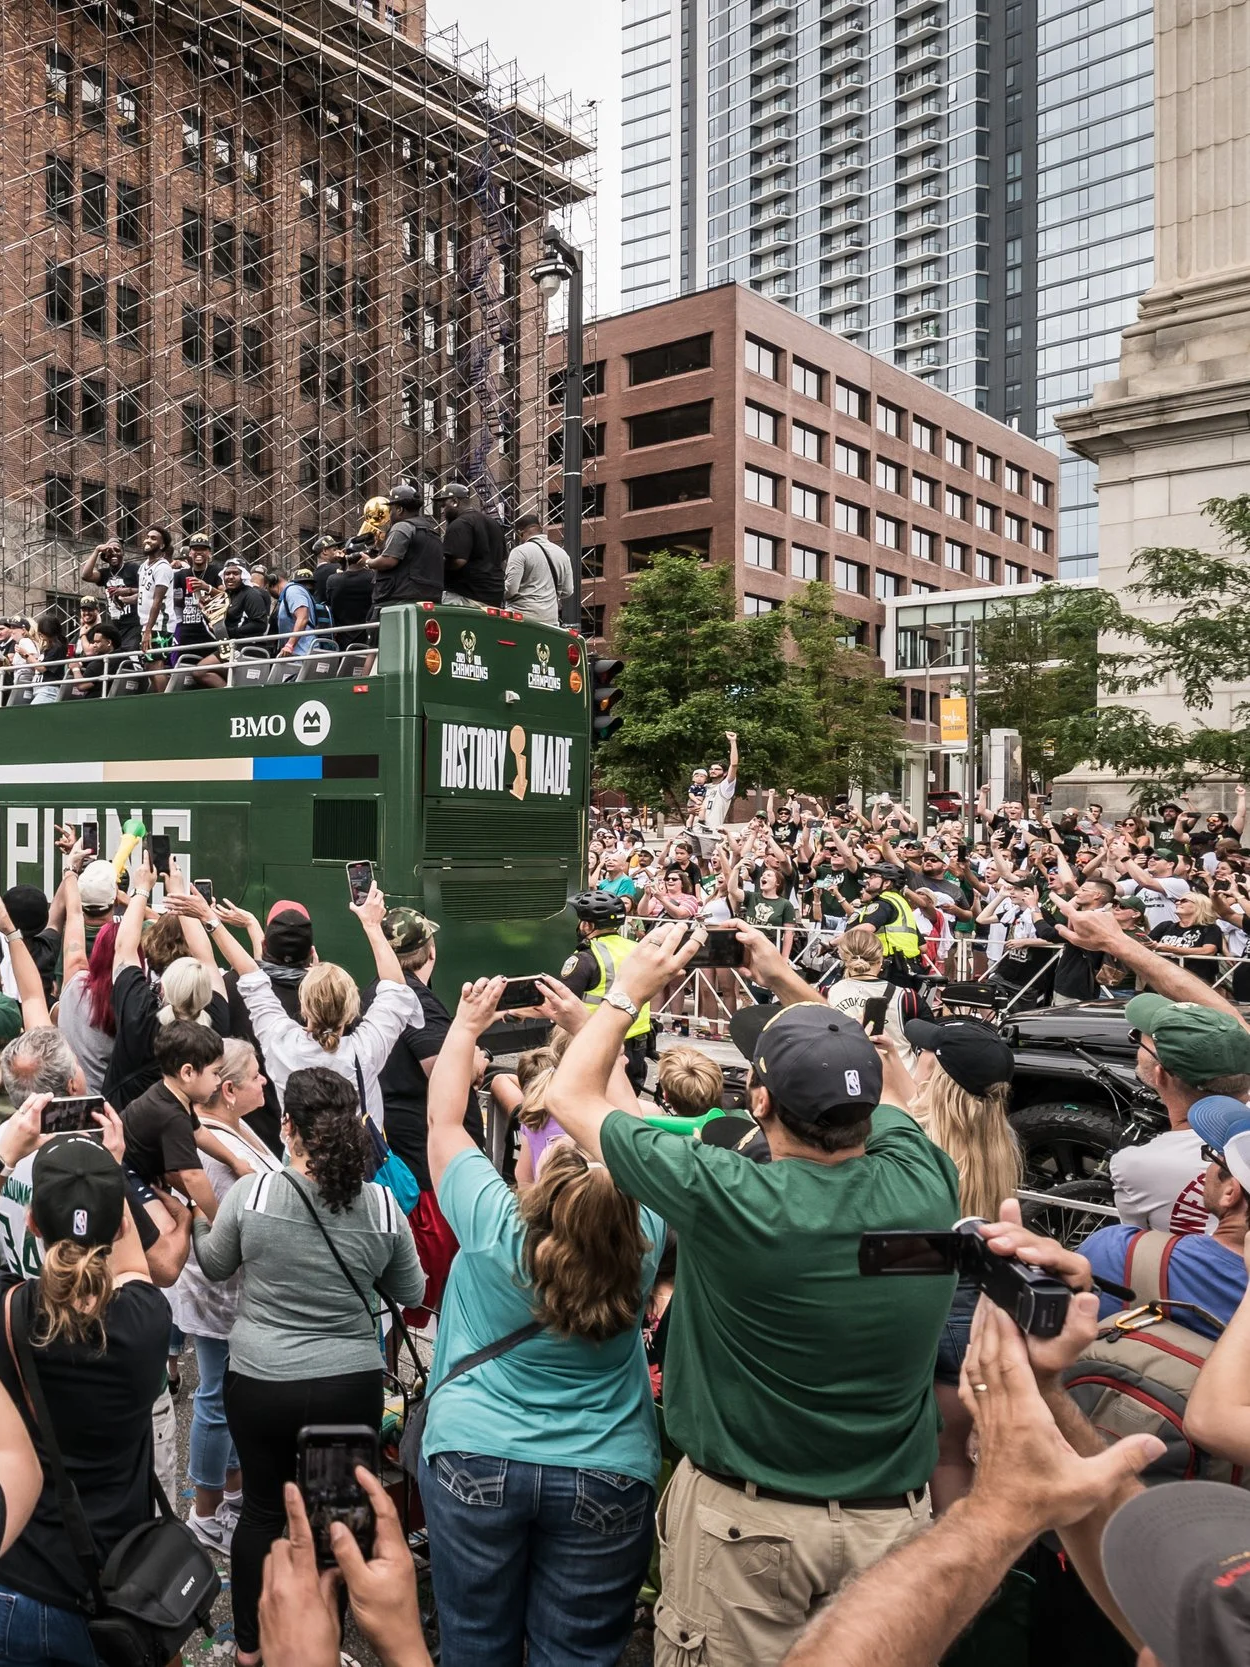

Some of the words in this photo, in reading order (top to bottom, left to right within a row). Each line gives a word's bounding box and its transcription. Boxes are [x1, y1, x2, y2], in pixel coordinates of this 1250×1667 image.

[451, 661, 489, 680] CHAMPIONS
[528, 673, 562, 690] CHAMPIONS
[230, 715, 286, 738] BMO
[440, 723, 508, 791] HISTORY
[530, 733, 572, 796] MADE
